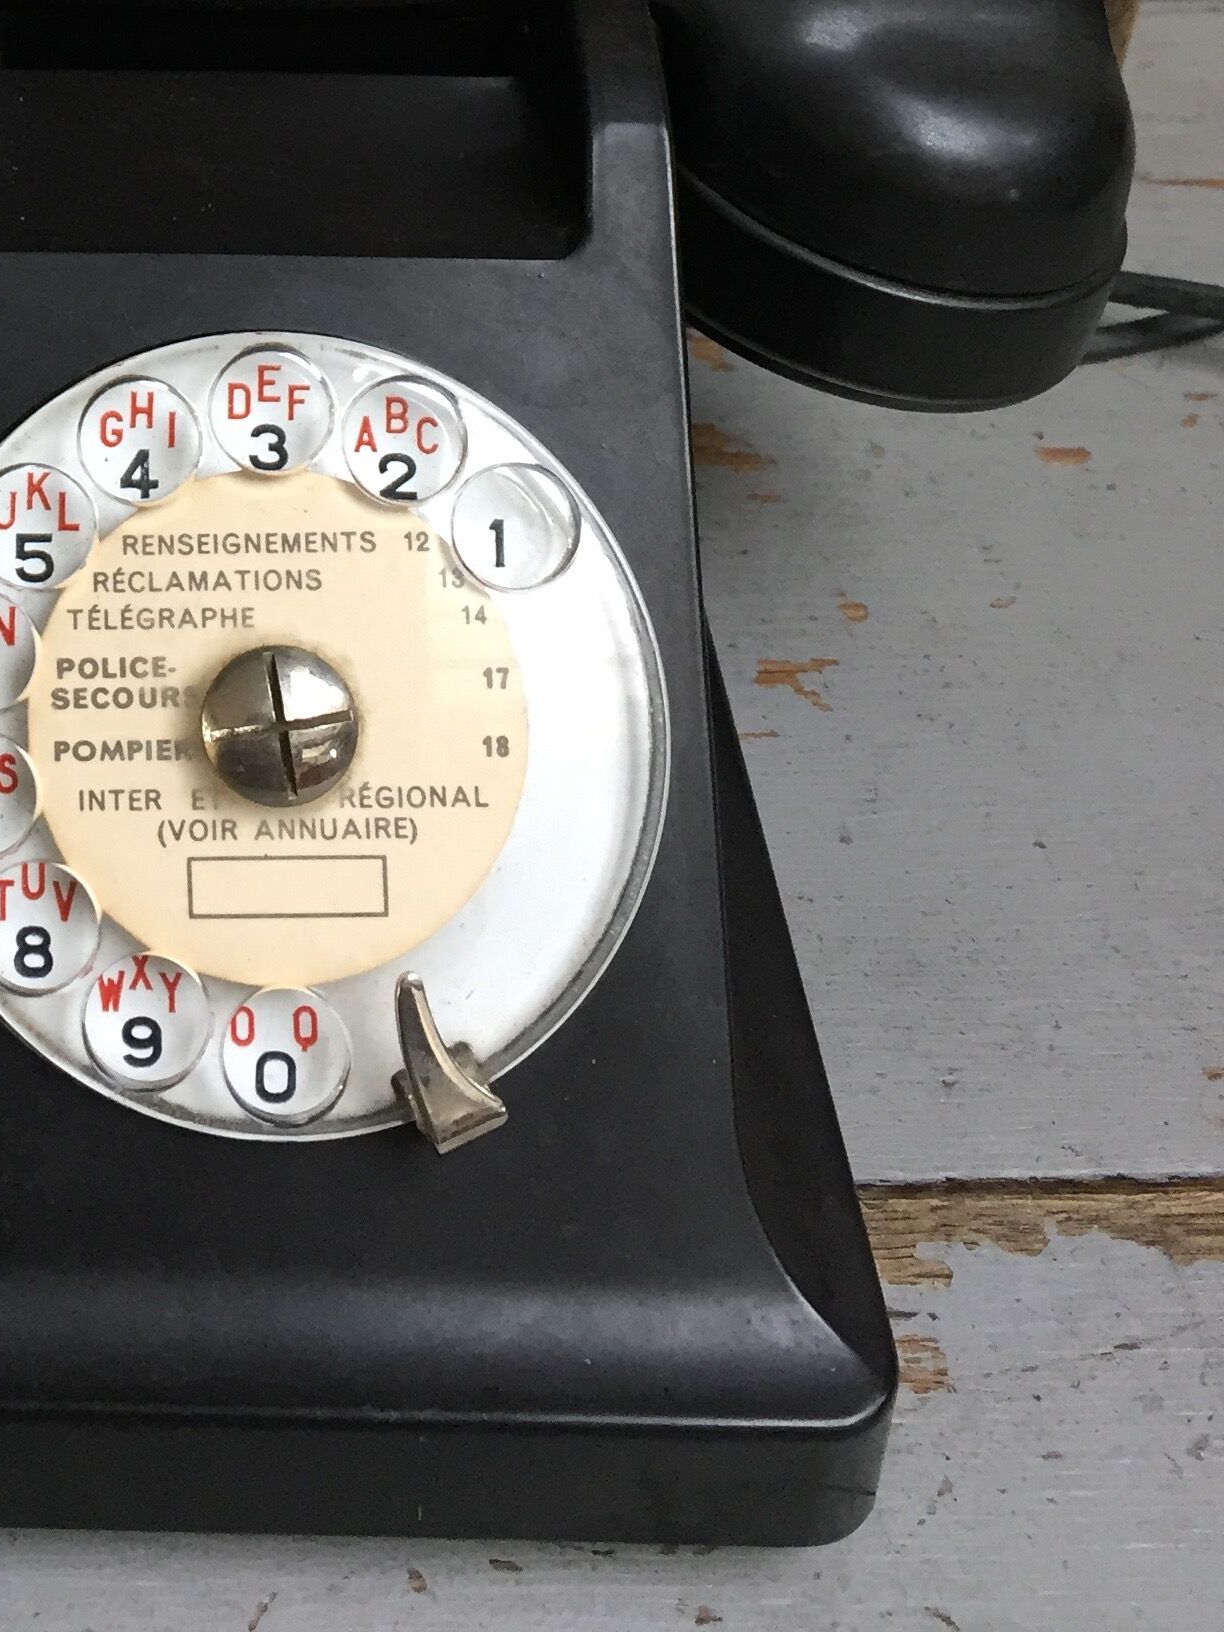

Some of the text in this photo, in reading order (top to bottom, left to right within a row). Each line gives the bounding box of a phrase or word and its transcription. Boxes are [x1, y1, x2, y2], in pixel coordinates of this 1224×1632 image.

[227, 364, 310, 421] DEF
[100, 391, 176, 448] GHI
[354, 396, 438, 454] ABC
[249, 423, 289, 471] 3
[120, 449, 159, 499] 4
[378, 452, 418, 500] 2
[15, 533, 55, 583] 5
[122, 531, 431, 555] RENSEIGNEMENTS 12
[488, 519, 506, 568] 1
[93, 567, 465, 593] RÉCLAMATIONS 13
[67, 603, 488, 631] TÉLÉGRAPHE 14
[56, 656, 177, 680] POLICE-
[483, 667, 510, 689] 17
[54, 735, 510, 762] POMPIER 18
[78, 789, 162, 811] INTER
[339, 781, 489, 809] RÉGIONAL
[157, 816, 419, 848] (VOIR ANNUAIRE)
[14, 925, 54, 978] 8
[122, 1016, 163, 1068] 9
[255, 1051, 296, 1103] 0
